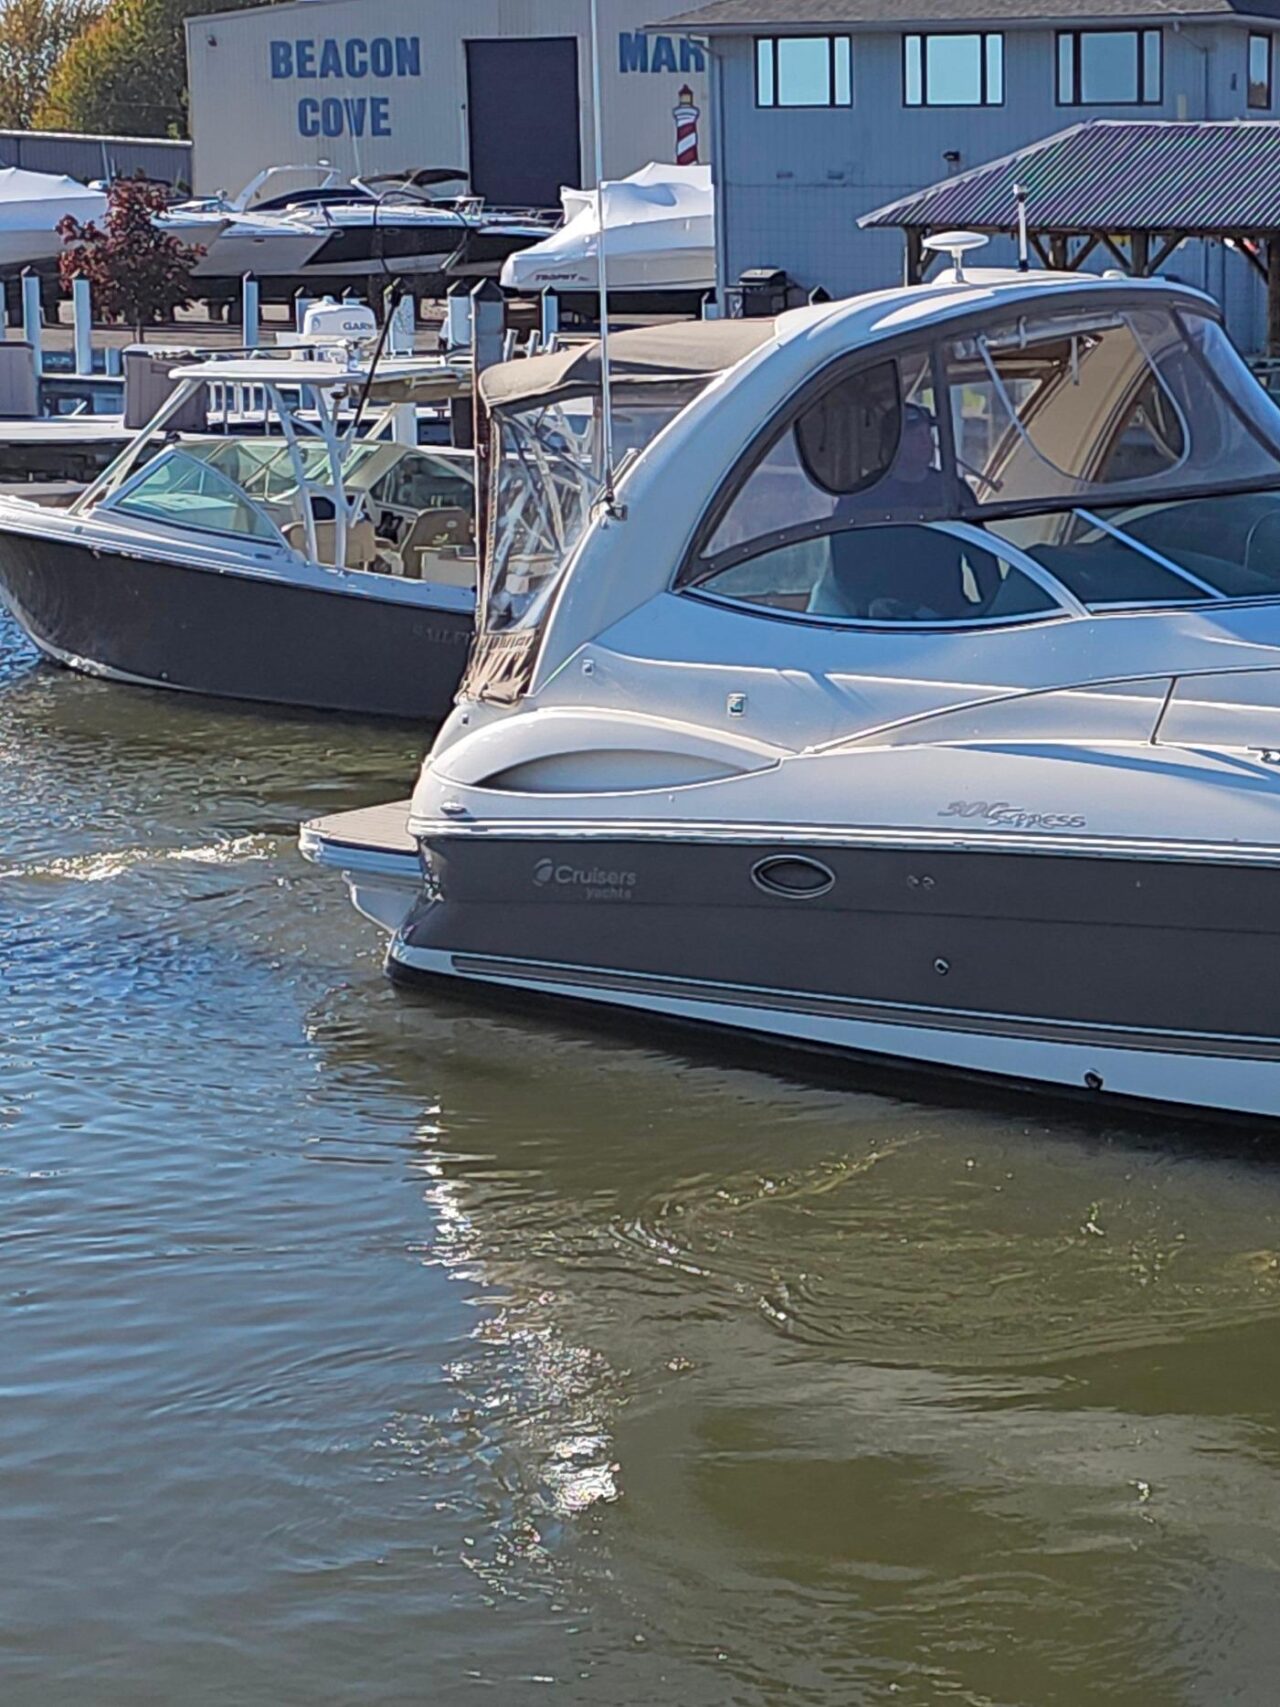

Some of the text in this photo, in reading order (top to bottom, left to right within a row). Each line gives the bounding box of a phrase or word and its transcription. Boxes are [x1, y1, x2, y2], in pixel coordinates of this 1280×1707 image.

[270, 36, 421, 78] BEACON
[298, 96, 392, 137] COVE
[555, 865, 637, 886] Cruisers
